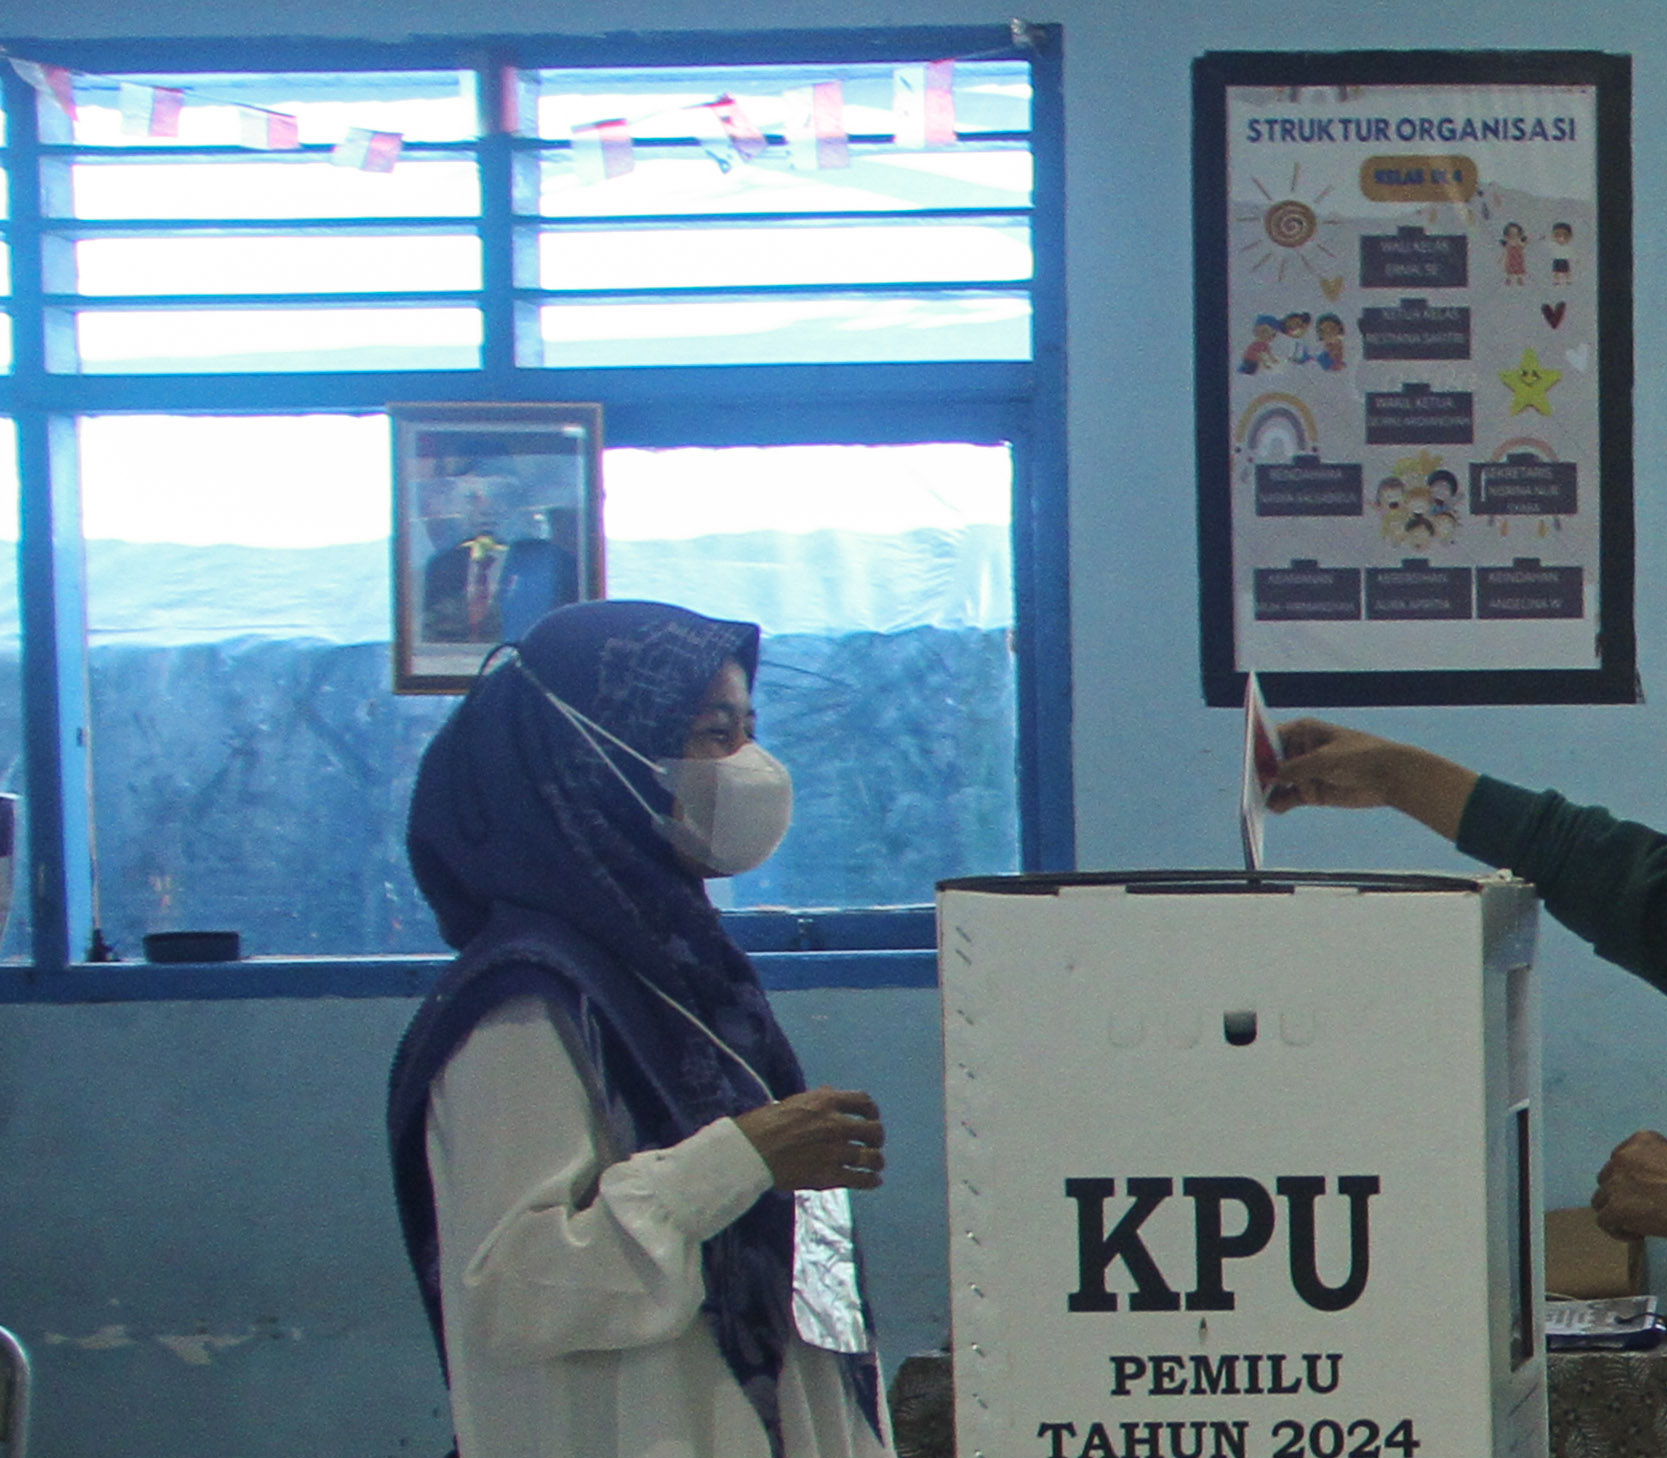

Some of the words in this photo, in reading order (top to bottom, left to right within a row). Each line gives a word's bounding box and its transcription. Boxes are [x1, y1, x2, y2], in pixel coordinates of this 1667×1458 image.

[1246, 117, 1390, 143] STRUKTUR
[1396, 116, 1576, 142] ORGANISASI
[1065, 1174, 1381, 1313] KPU
[1110, 1353, 1343, 1397] PEMILU
